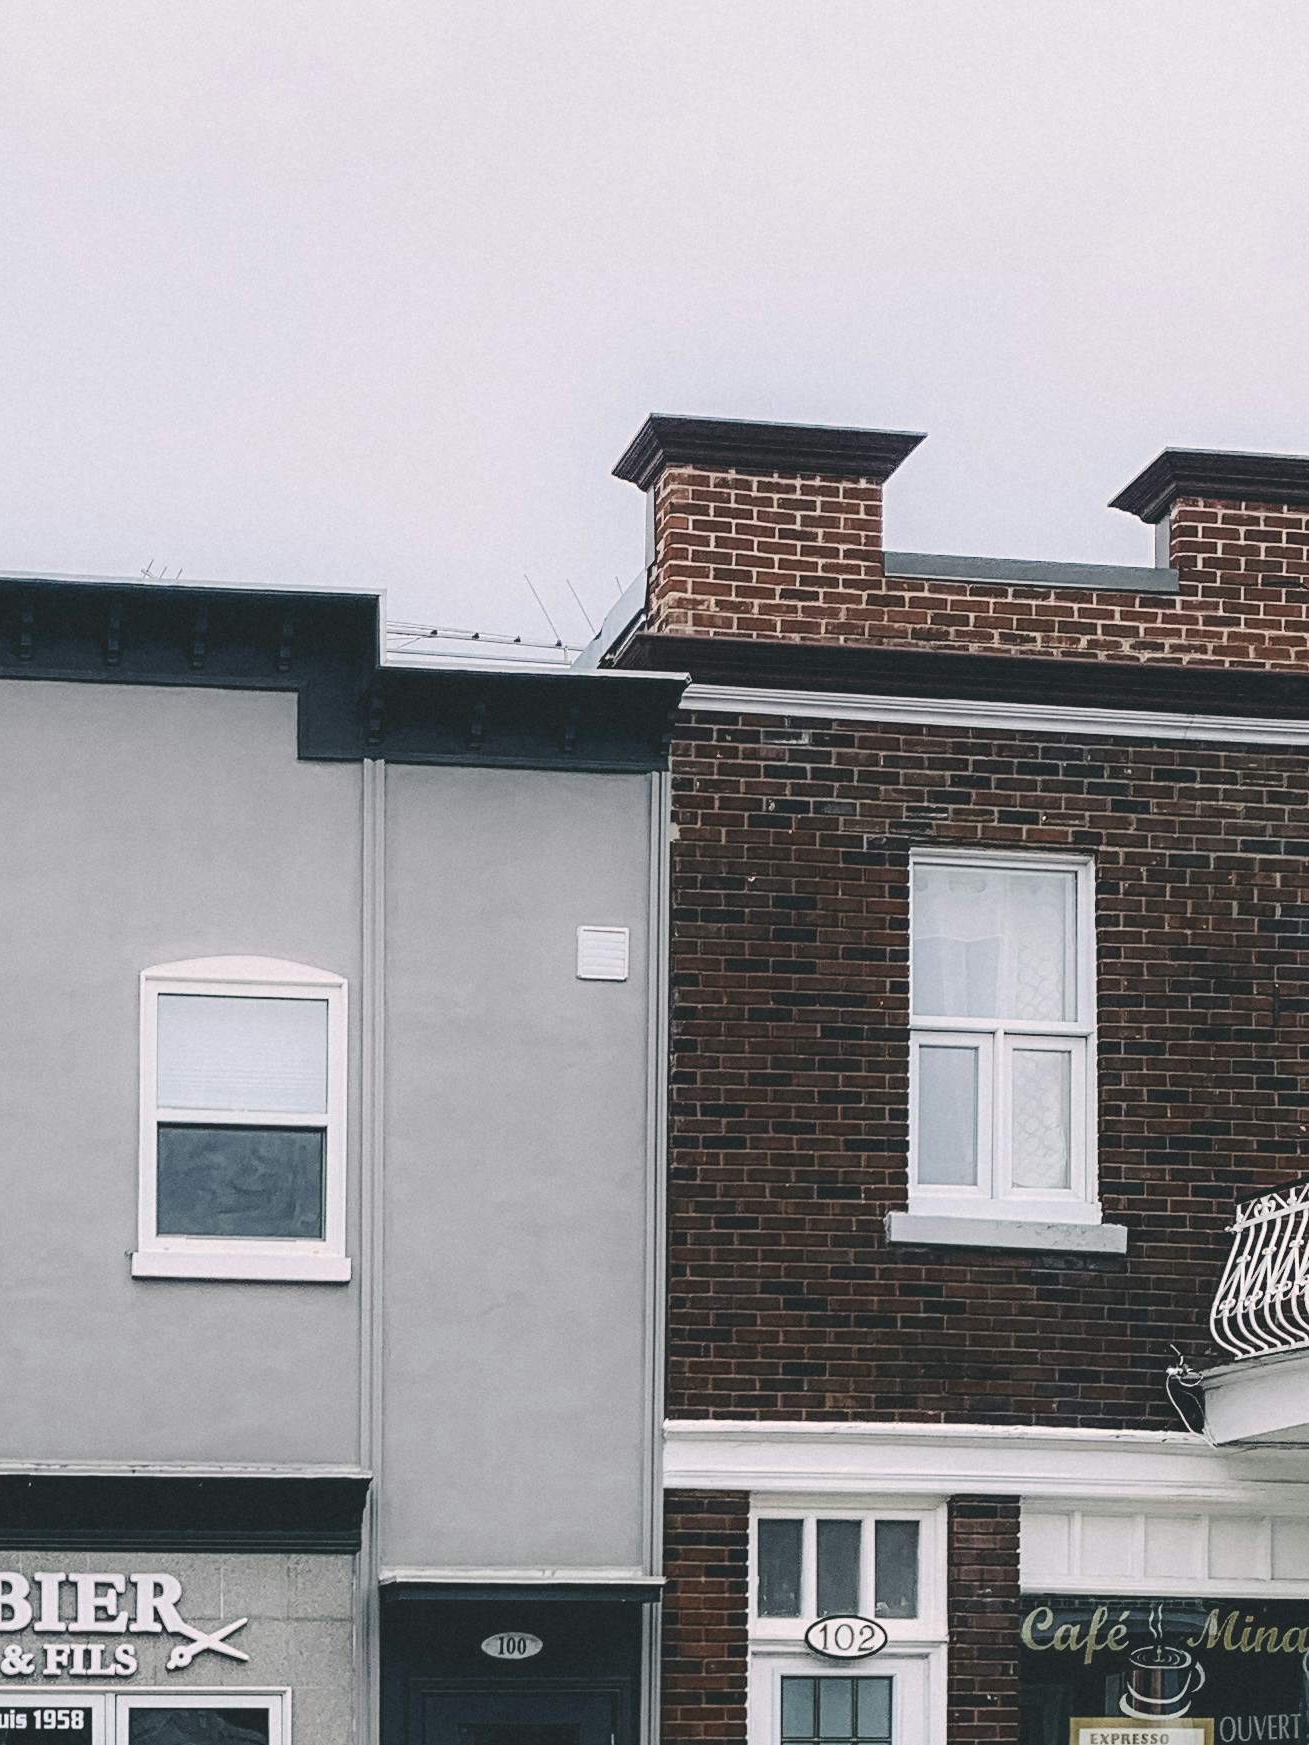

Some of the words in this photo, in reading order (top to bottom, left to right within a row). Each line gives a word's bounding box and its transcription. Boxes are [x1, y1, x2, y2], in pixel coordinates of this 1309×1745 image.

[498, 1636, 527, 1655] 100
[819, 1623, 875, 1651] 102
[1020, 1605, 1129, 1665] Café
[0, 1644, 34, 1676] &
[42, 1643, 137, 1677] FILS
[33, 1709, 85, 1730] 1958
[1219, 1713, 1302, 1743] OUVERT
[1090, 1733, 1170, 1745] EXPRESSO
